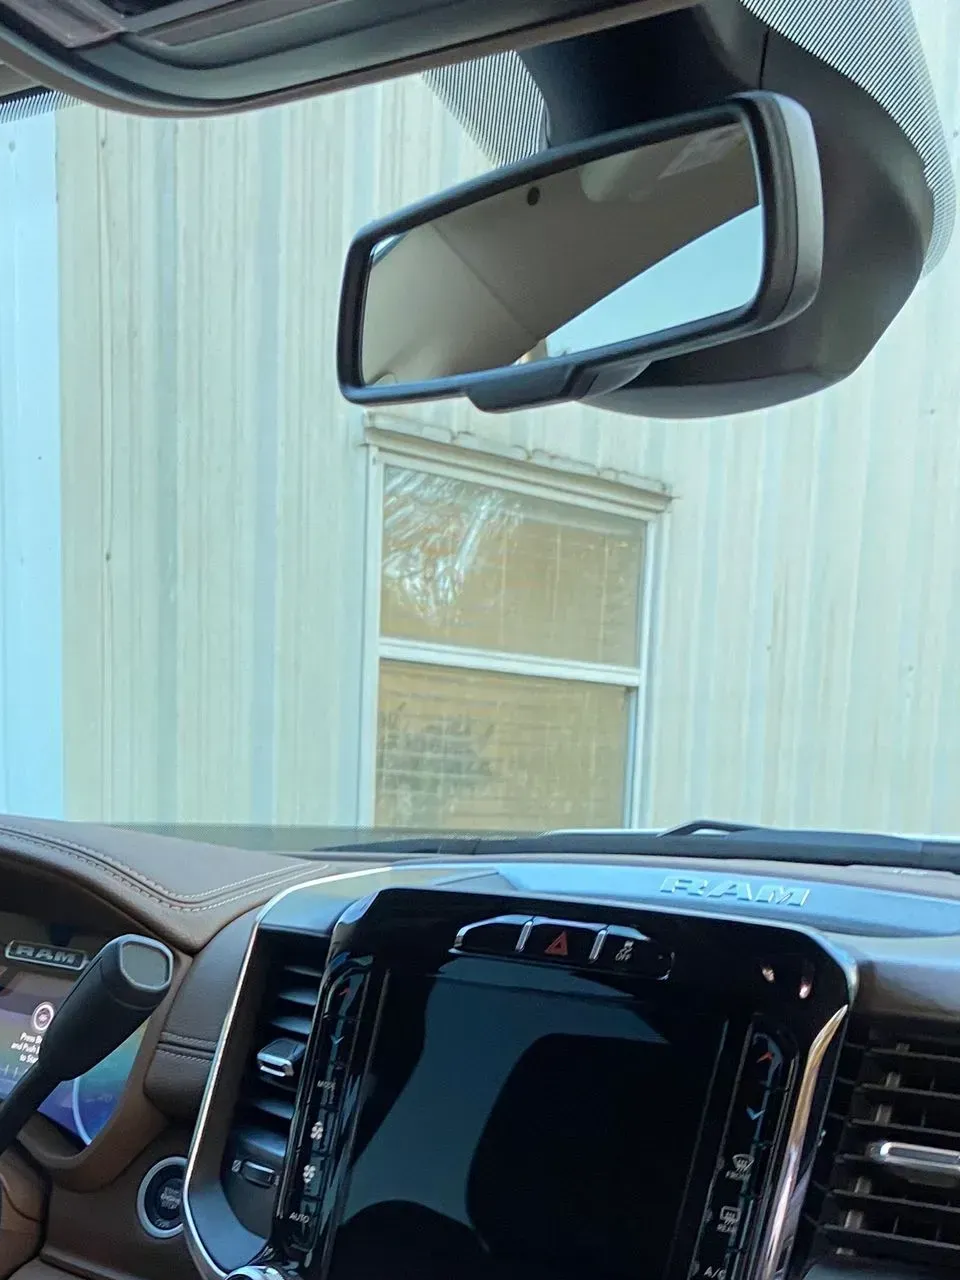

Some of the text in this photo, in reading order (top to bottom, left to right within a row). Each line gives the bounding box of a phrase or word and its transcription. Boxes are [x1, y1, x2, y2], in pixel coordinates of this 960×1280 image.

[659, 875, 811, 907] RAM
[14, 944, 76, 965] RAM
[288, 1211, 310, 1224] AUTO
[703, 1266, 727, 1280] A/C
